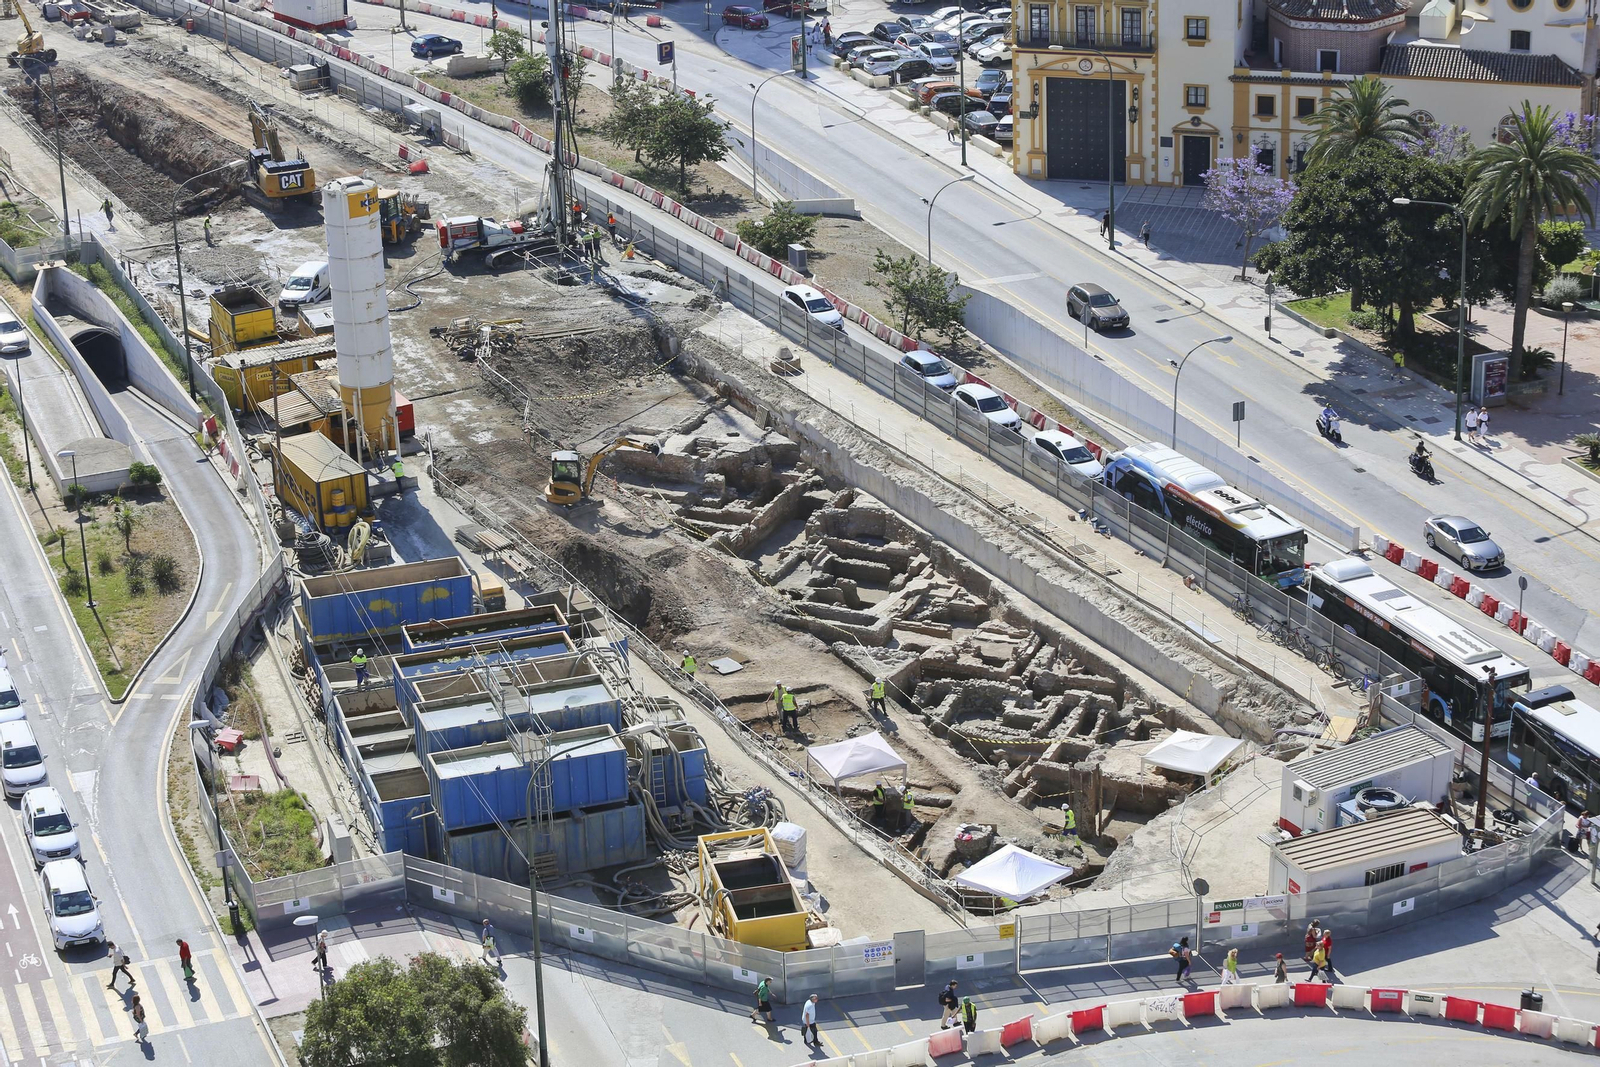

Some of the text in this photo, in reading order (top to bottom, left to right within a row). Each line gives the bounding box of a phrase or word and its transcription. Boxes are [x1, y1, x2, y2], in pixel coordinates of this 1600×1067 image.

[662, 44, 671, 57] P
[281, 173, 303, 189] CAT
[1186, 514, 1212, 536] eléctrico
[1217, 902, 1242, 910] SANDO
